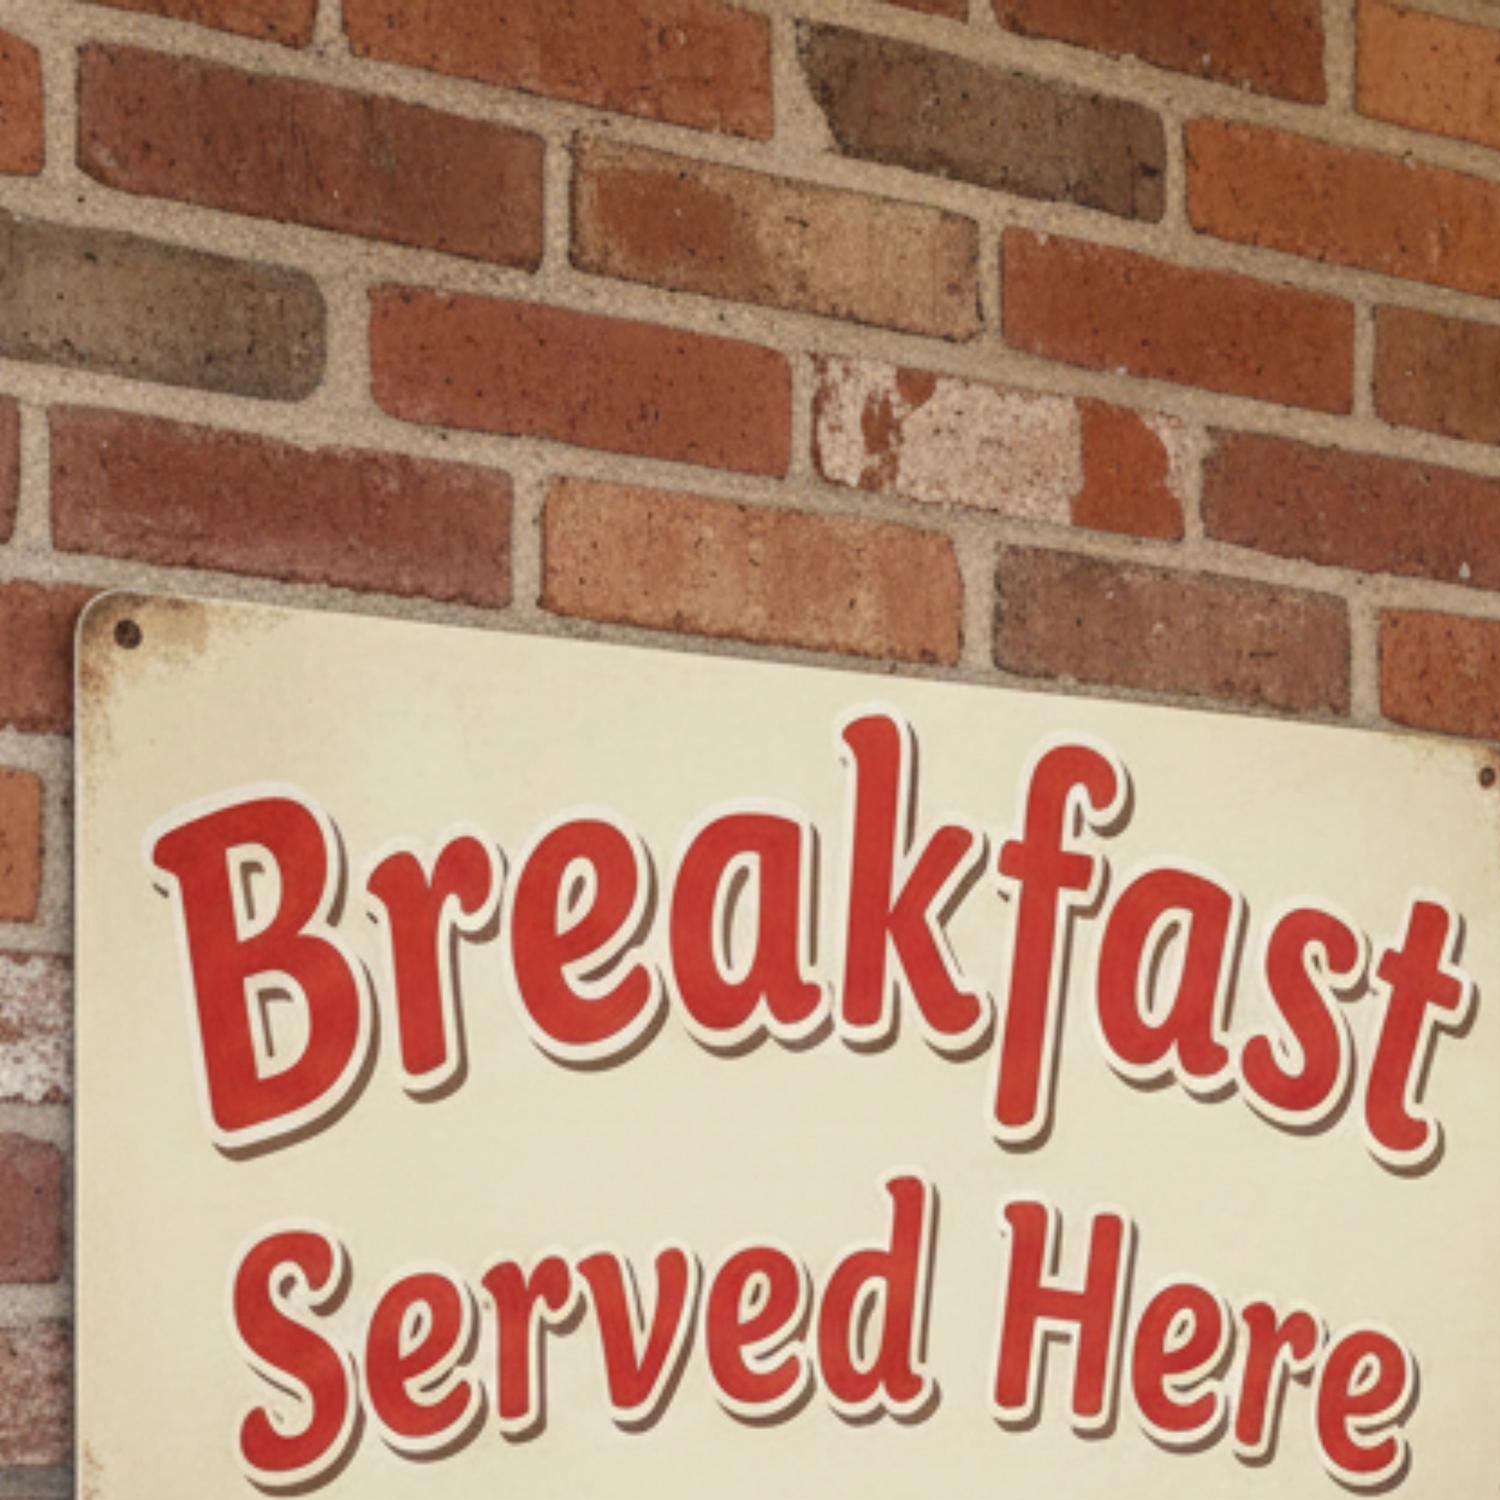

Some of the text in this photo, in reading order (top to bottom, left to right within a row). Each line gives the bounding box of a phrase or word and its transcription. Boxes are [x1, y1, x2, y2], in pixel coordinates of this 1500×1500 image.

[149, 708, 1471, 1164] Breakfast
[229, 1172, 1414, 1482] Served Here
